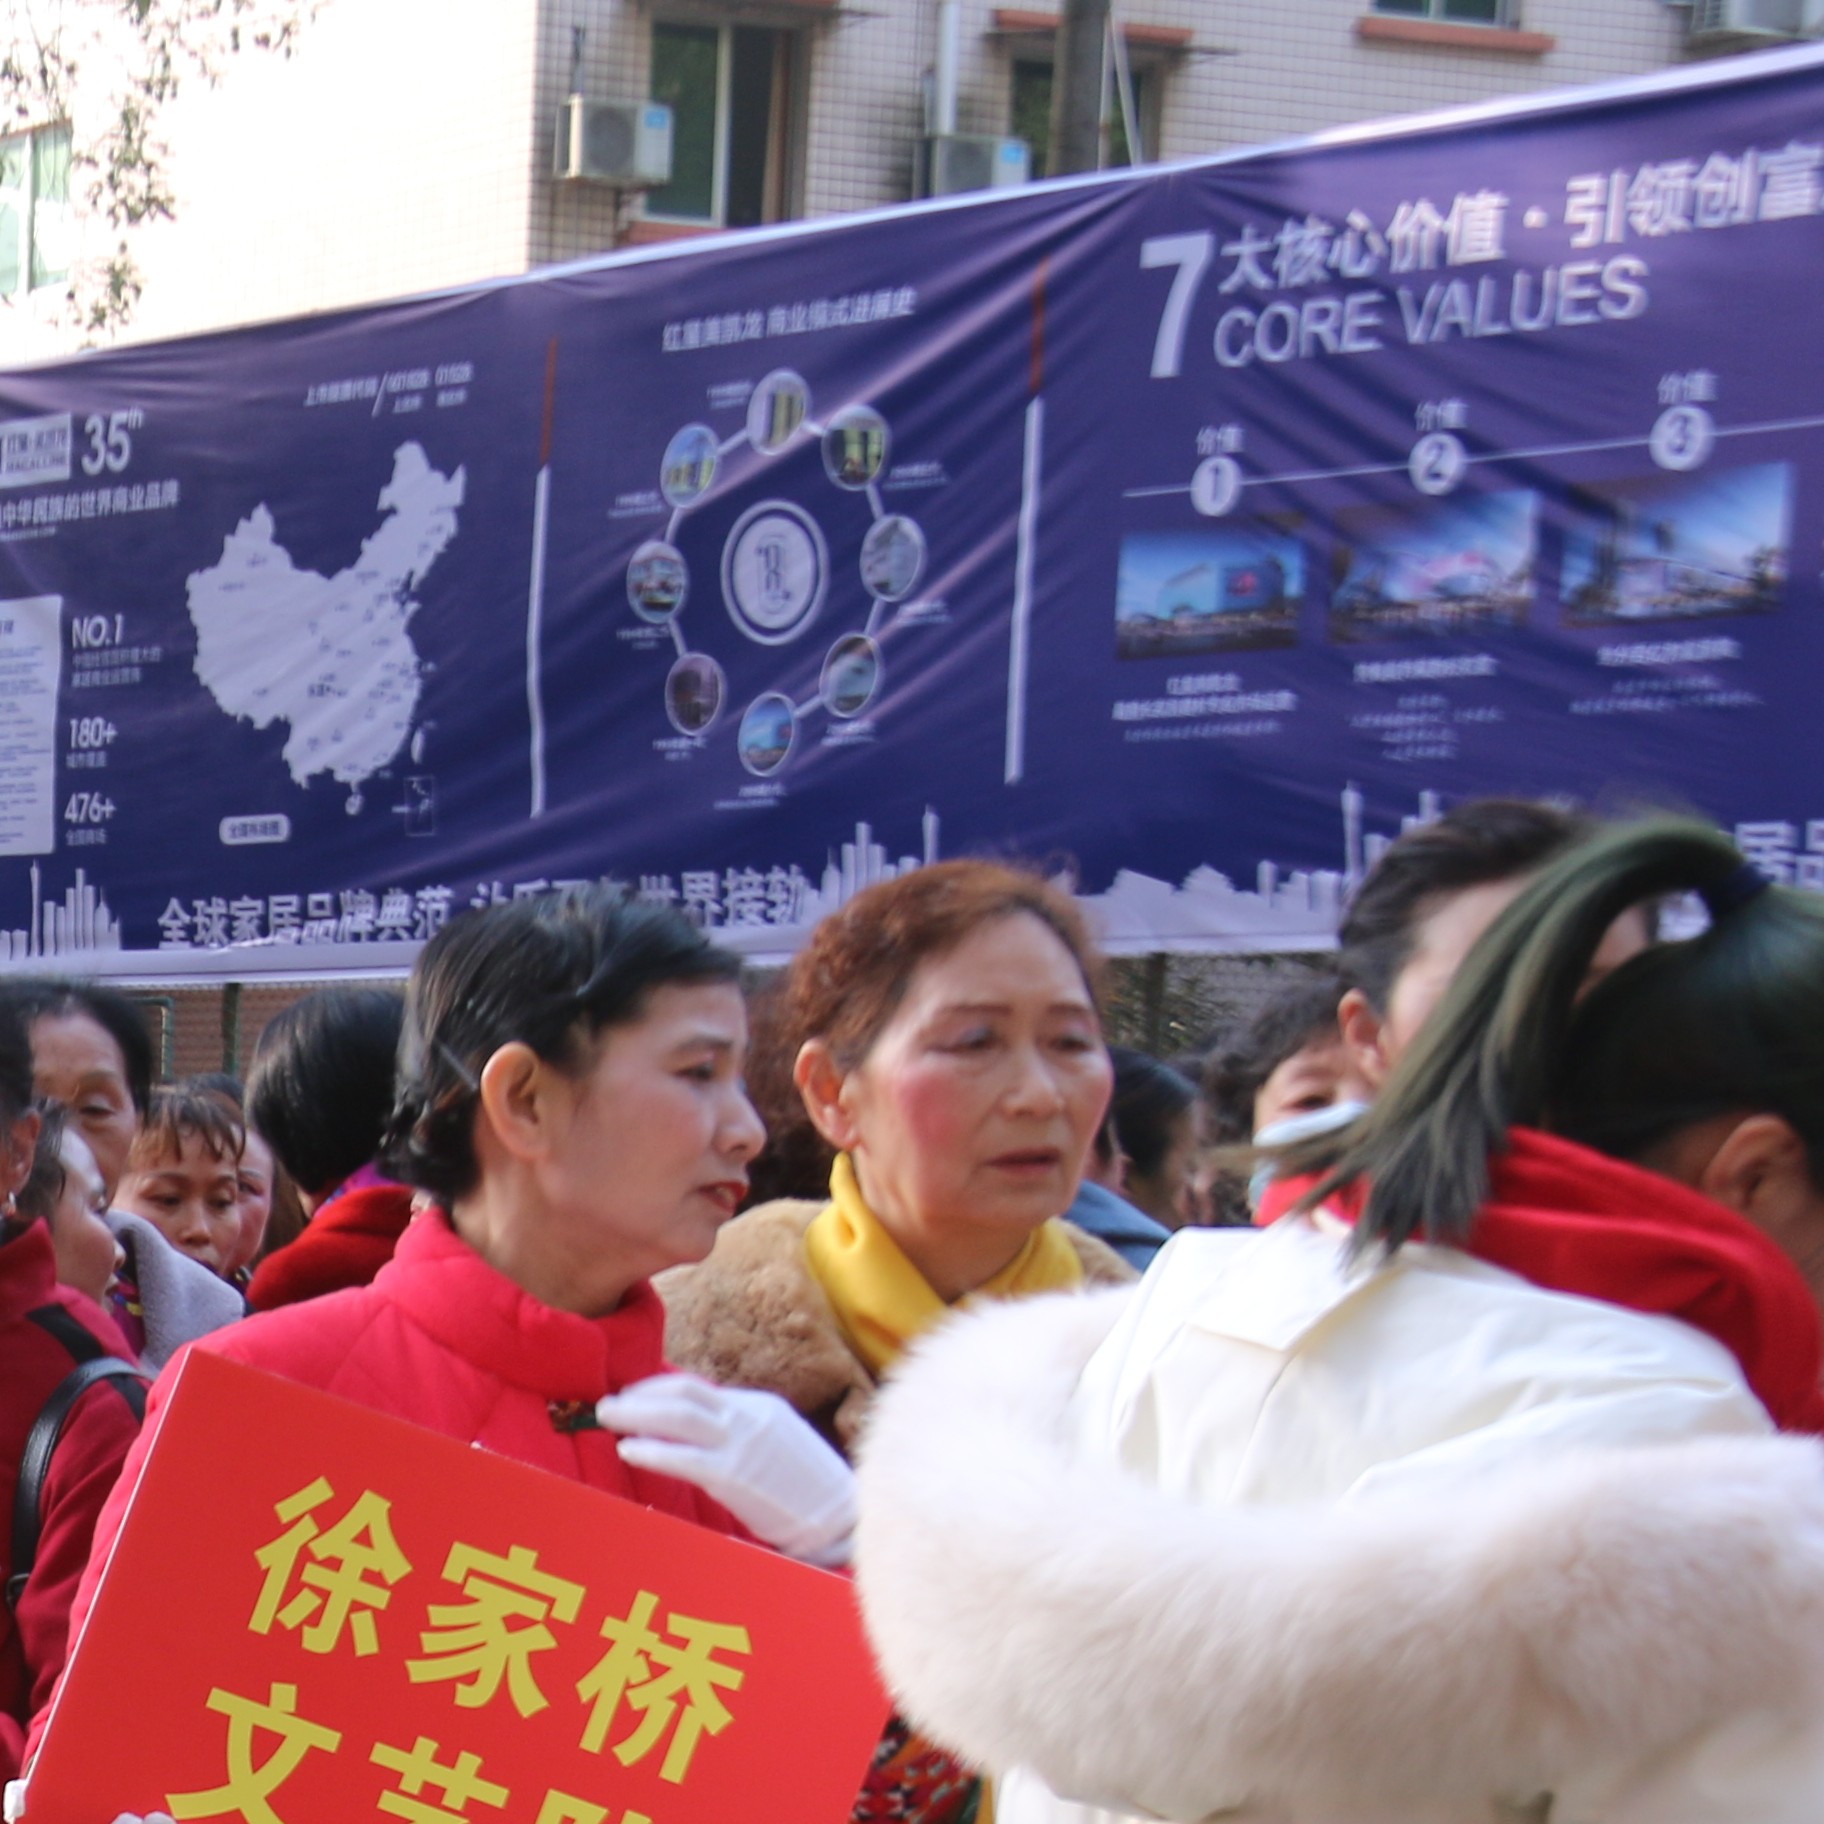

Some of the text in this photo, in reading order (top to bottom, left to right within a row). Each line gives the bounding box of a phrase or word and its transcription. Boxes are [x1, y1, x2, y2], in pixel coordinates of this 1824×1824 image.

[1140, 230, 1214, 378] 7
[1213, 254, 1649, 368] CORE VALUES
[72, 613, 124, 648] NO.1
[70, 715, 118, 749] 180+
[63, 791, 116, 823] 476+
[157, 883, 455, 951] 全球家居品牌典范
[247, 1475, 753, 1785] 徐家桥
